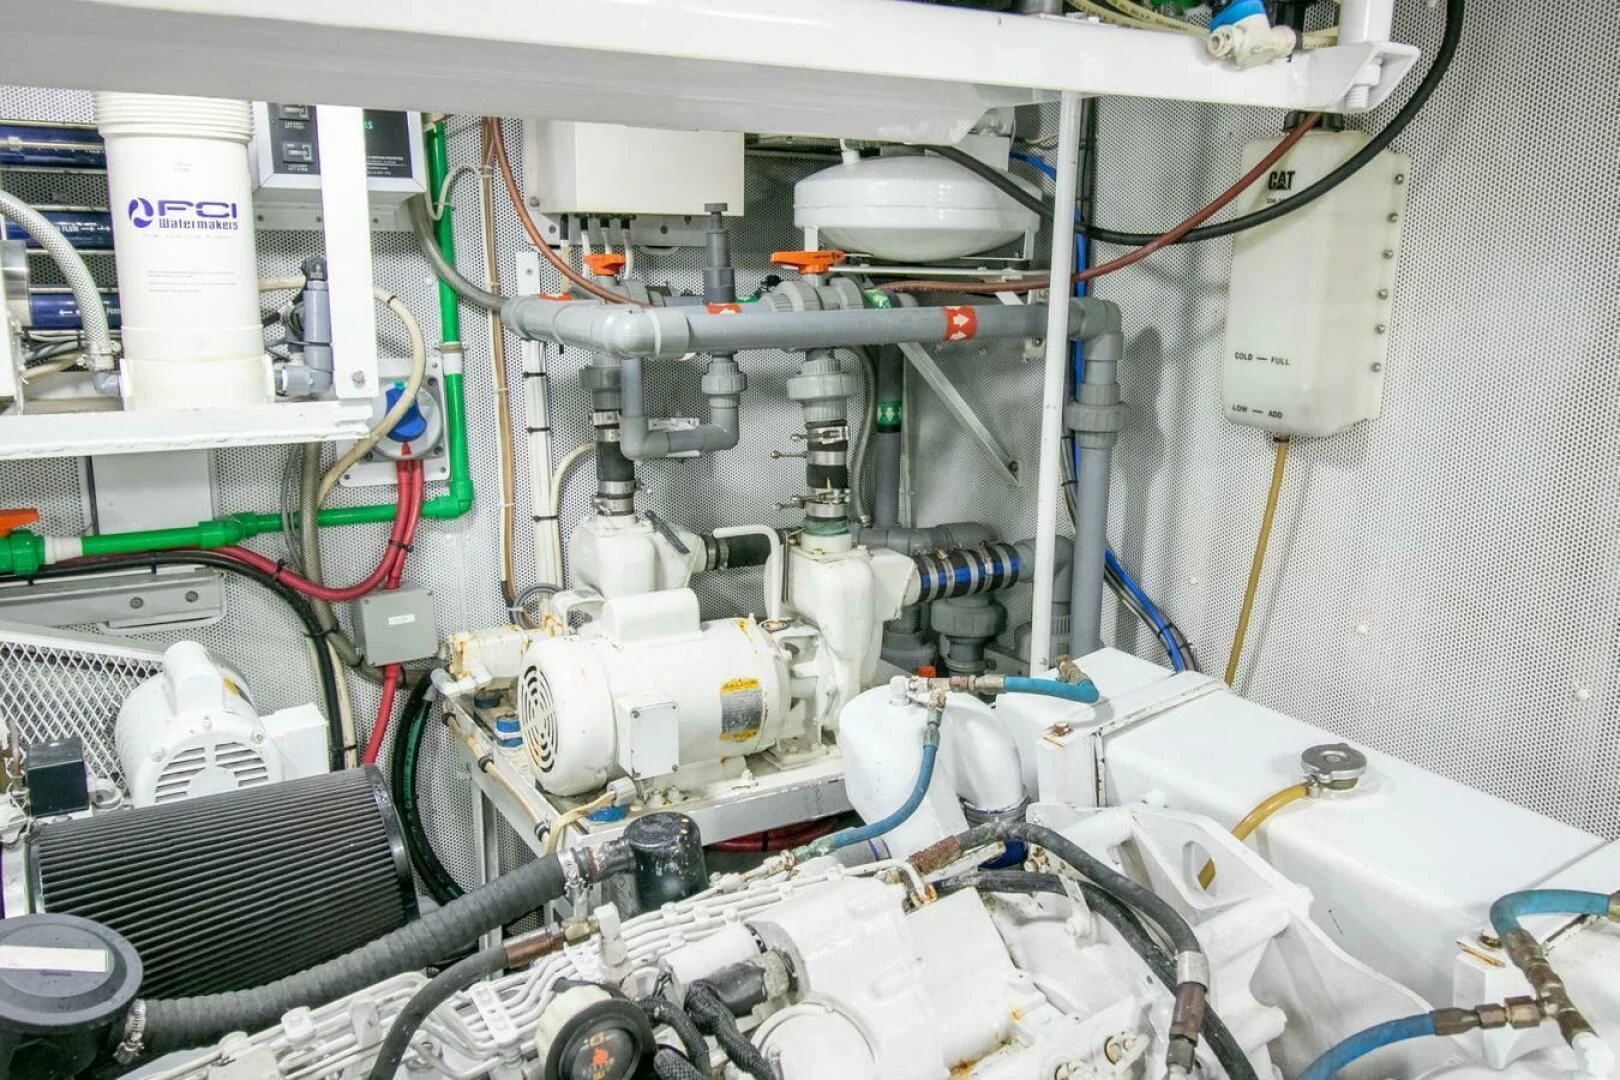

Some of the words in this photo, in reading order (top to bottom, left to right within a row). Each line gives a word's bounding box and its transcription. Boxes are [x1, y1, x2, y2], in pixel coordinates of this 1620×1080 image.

[1268, 170, 1296, 190] CAT
[158, 200, 238, 219] FCI
[158, 217, 239, 231] Watermakers
[1234, 351, 1254, 361] COLD
[1271, 356, 1290, 366] FULL
[1232, 403, 1249, 413] LOW
[1268, 410, 1284, 420] ADD
